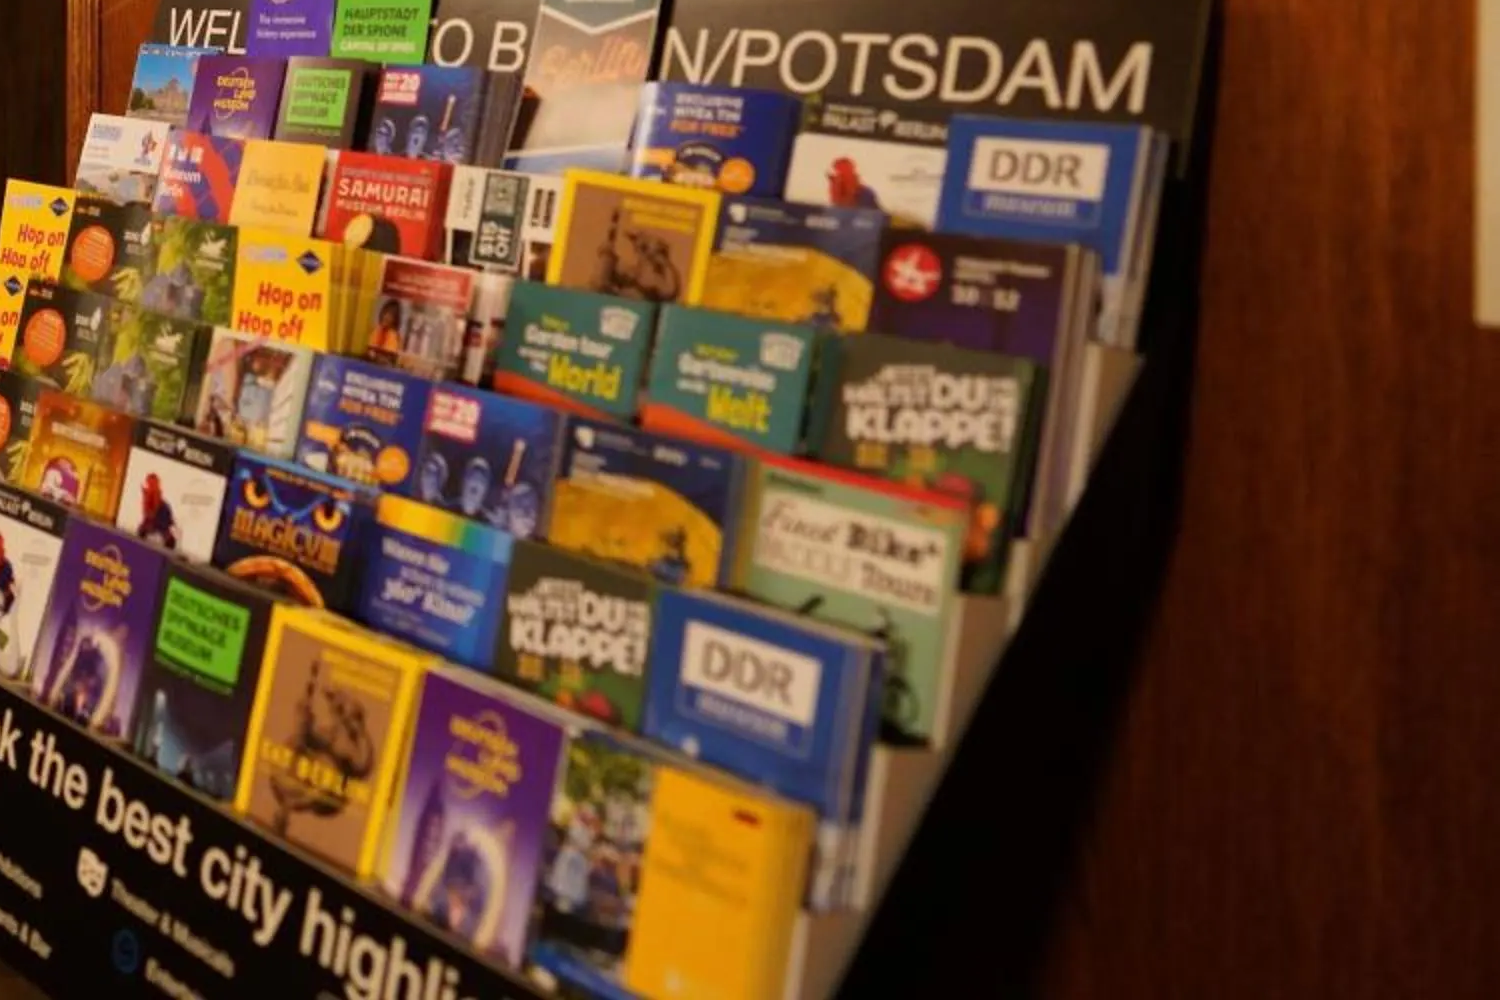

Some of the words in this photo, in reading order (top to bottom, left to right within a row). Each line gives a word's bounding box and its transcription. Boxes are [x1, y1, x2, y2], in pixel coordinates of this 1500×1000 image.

[344, 7, 420, 21] HAUPTSTADT
[367, 24, 407, 37] SPIONE
[169, 8, 247, 56] WEL
[432, 18, 473, 68] O
[989, 149, 1082, 189] DDR
[336, 199, 384, 214] MUSEUM
[385, 205, 427, 221] BERLIN
[338, 178, 430, 209] SAMURAI
[17, 223, 44, 244] Hop
[48, 231, 66, 247] on
[0, 248, 27, 270] Hop
[29, 252, 51, 274] off
[257, 280, 294, 313] Hop
[298, 291, 323, 309] on
[2, 309, 19, 325] on
[237, 311, 273, 337] Hop
[278, 317, 305, 343] off
[549, 352, 623, 401] World
[932, 373, 988, 412] DU
[708, 382, 771, 434] Welt
[578, 590, 626, 632] DU
[702, 639, 796, 706] DDR
[29, 732, 90, 811] the
[96, 766, 195, 879] best
[200, 844, 292, 947] city
[301, 887, 470, 1000] highli
